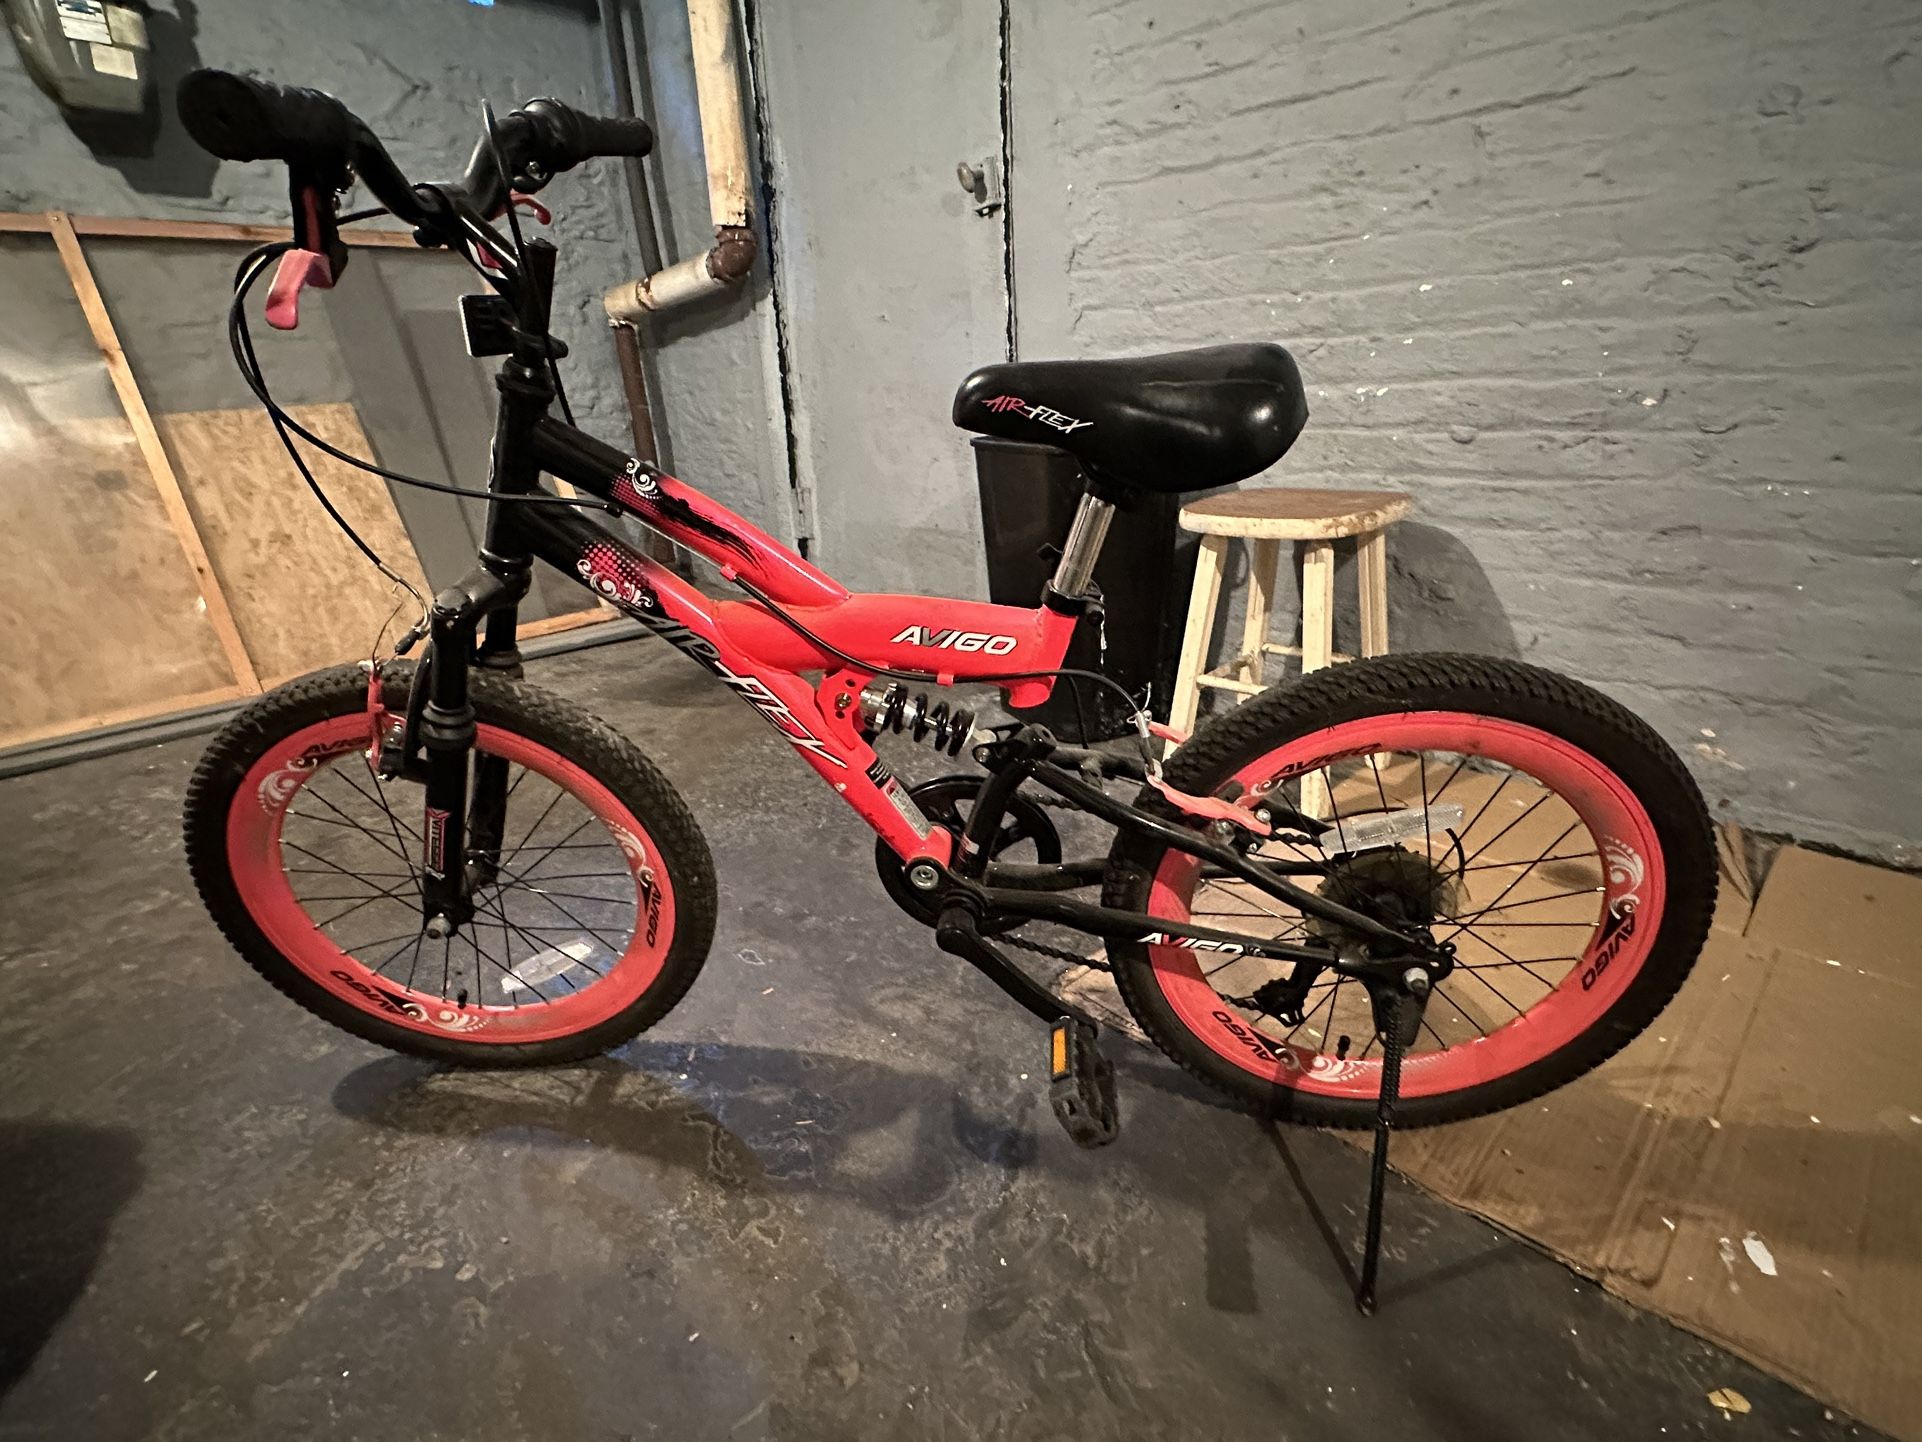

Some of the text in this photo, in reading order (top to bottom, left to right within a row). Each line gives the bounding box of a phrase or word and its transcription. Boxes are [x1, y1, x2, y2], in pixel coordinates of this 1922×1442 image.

[981, 395, 1094, 434] AIR-FLEX
[889, 624, 1018, 656] AVIGO
[646, 881, 663, 949] AVIGO
[1581, 912, 1636, 992] AVIGO
[1211, 1010, 1280, 1064] AVIGO
